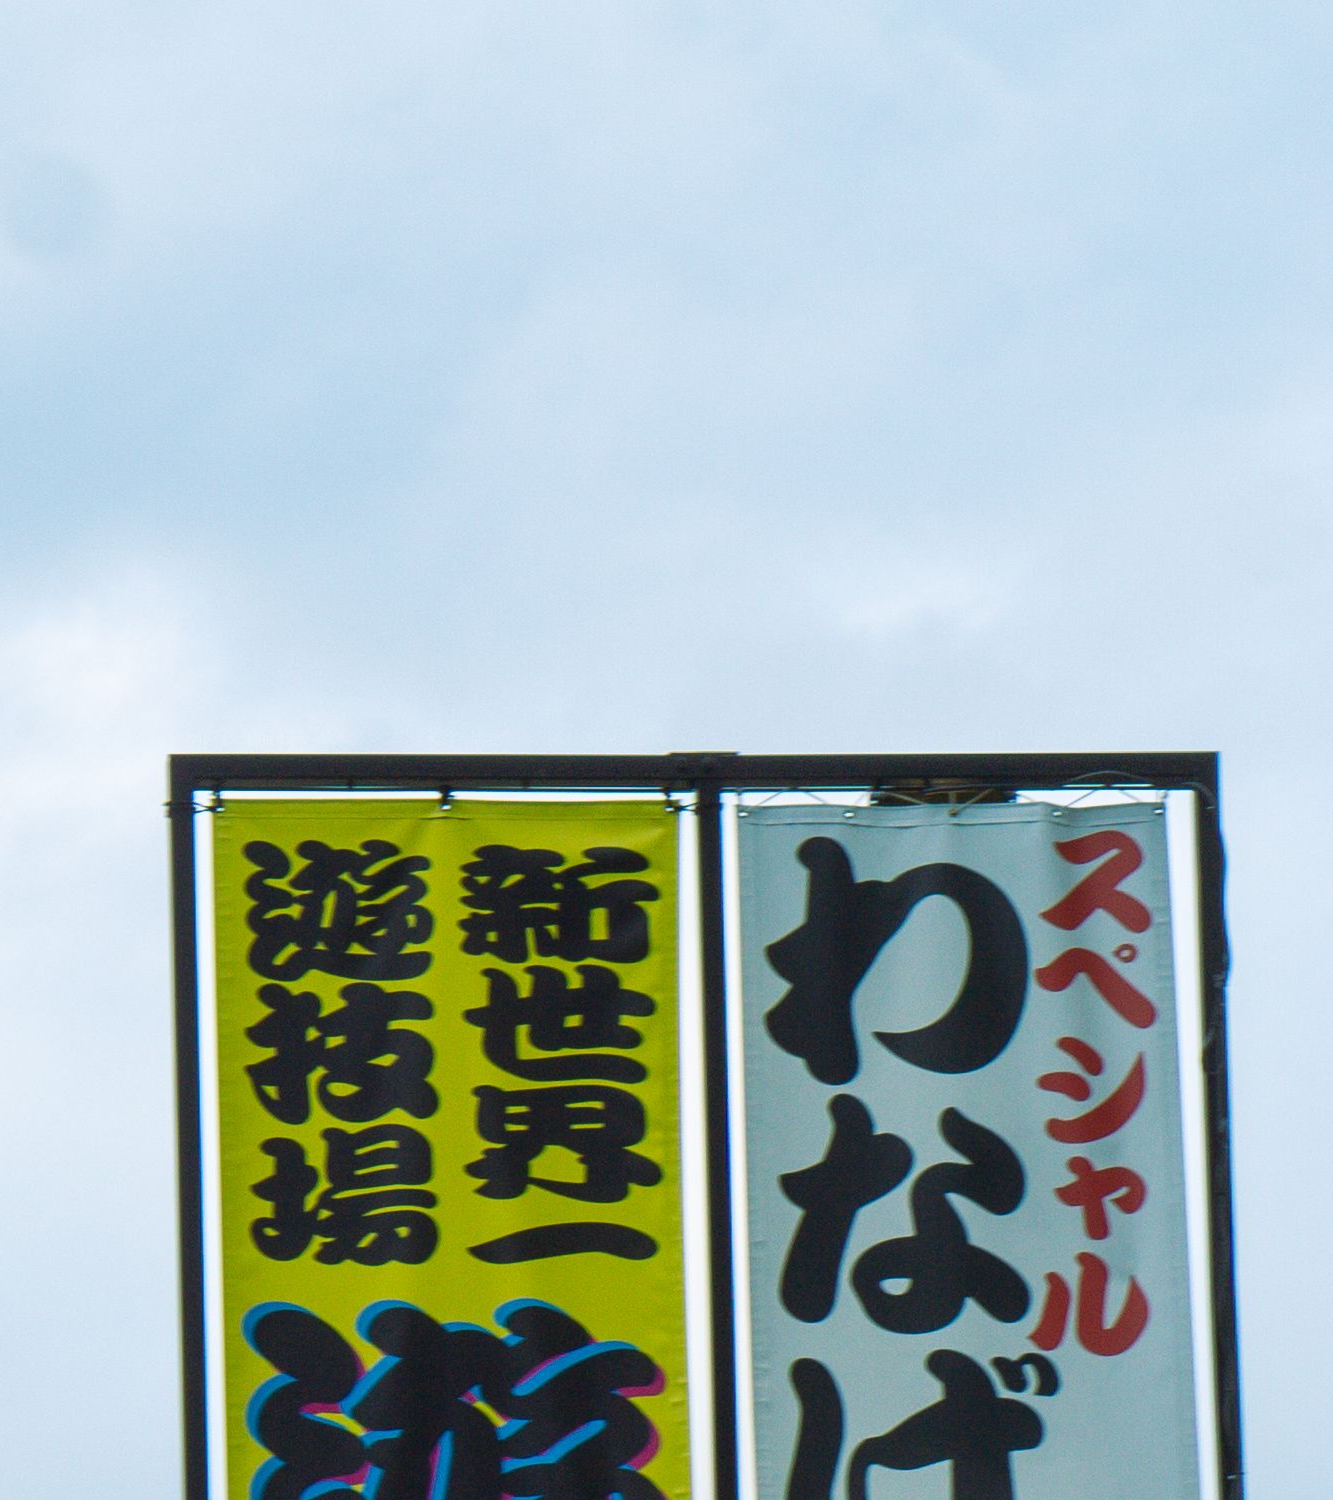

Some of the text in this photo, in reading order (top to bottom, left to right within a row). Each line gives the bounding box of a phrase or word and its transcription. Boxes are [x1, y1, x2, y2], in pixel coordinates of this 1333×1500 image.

[242, 839, 440, 1266] 遊技場
[460, 843, 663, 1264] 新世界一
[1030, 829, 1157, 1357] スペシャル
